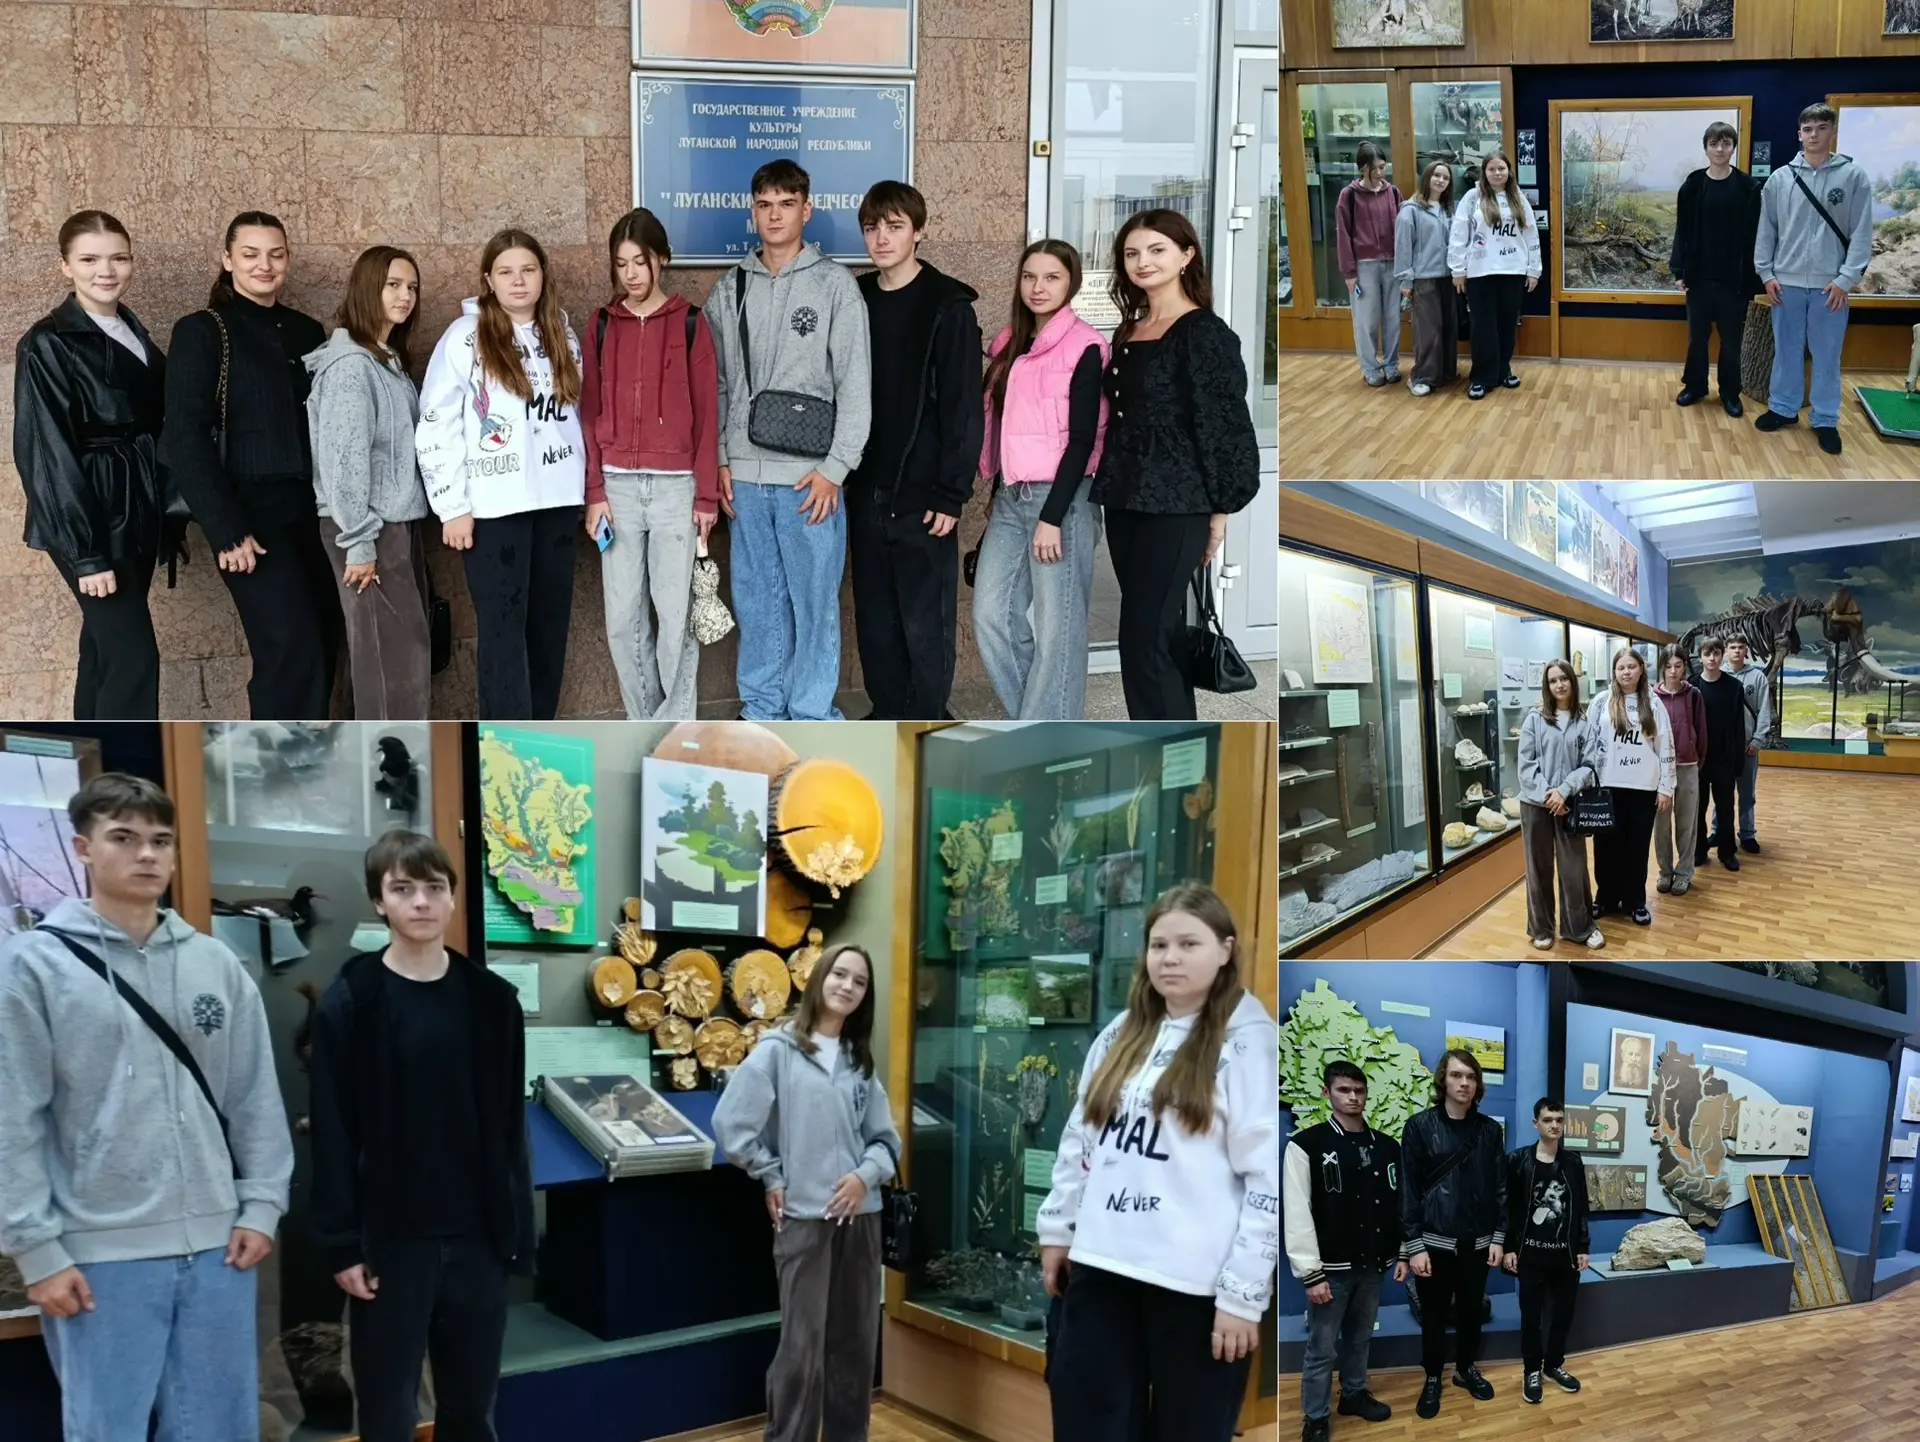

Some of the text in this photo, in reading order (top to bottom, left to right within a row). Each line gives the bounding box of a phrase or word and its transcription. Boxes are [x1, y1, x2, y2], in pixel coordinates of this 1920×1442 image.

[692, 103, 857, 118] ГОСУДАРСТВЕННОЕ УЧРЕЖДЕНИЕ
[749, 122, 802, 133] КУЛЬТУРЫ
[678, 136, 872, 151] ЛУГАНСКОЙ НАРОДНОЙ РЕСПУБЛИКИ
[1492, 221, 1517, 237] MAL
[542, 444, 575, 466] NEVER
[1098, 1108, 1169, 1162] MAL
[1106, 1187, 1161, 1213] NEVER
